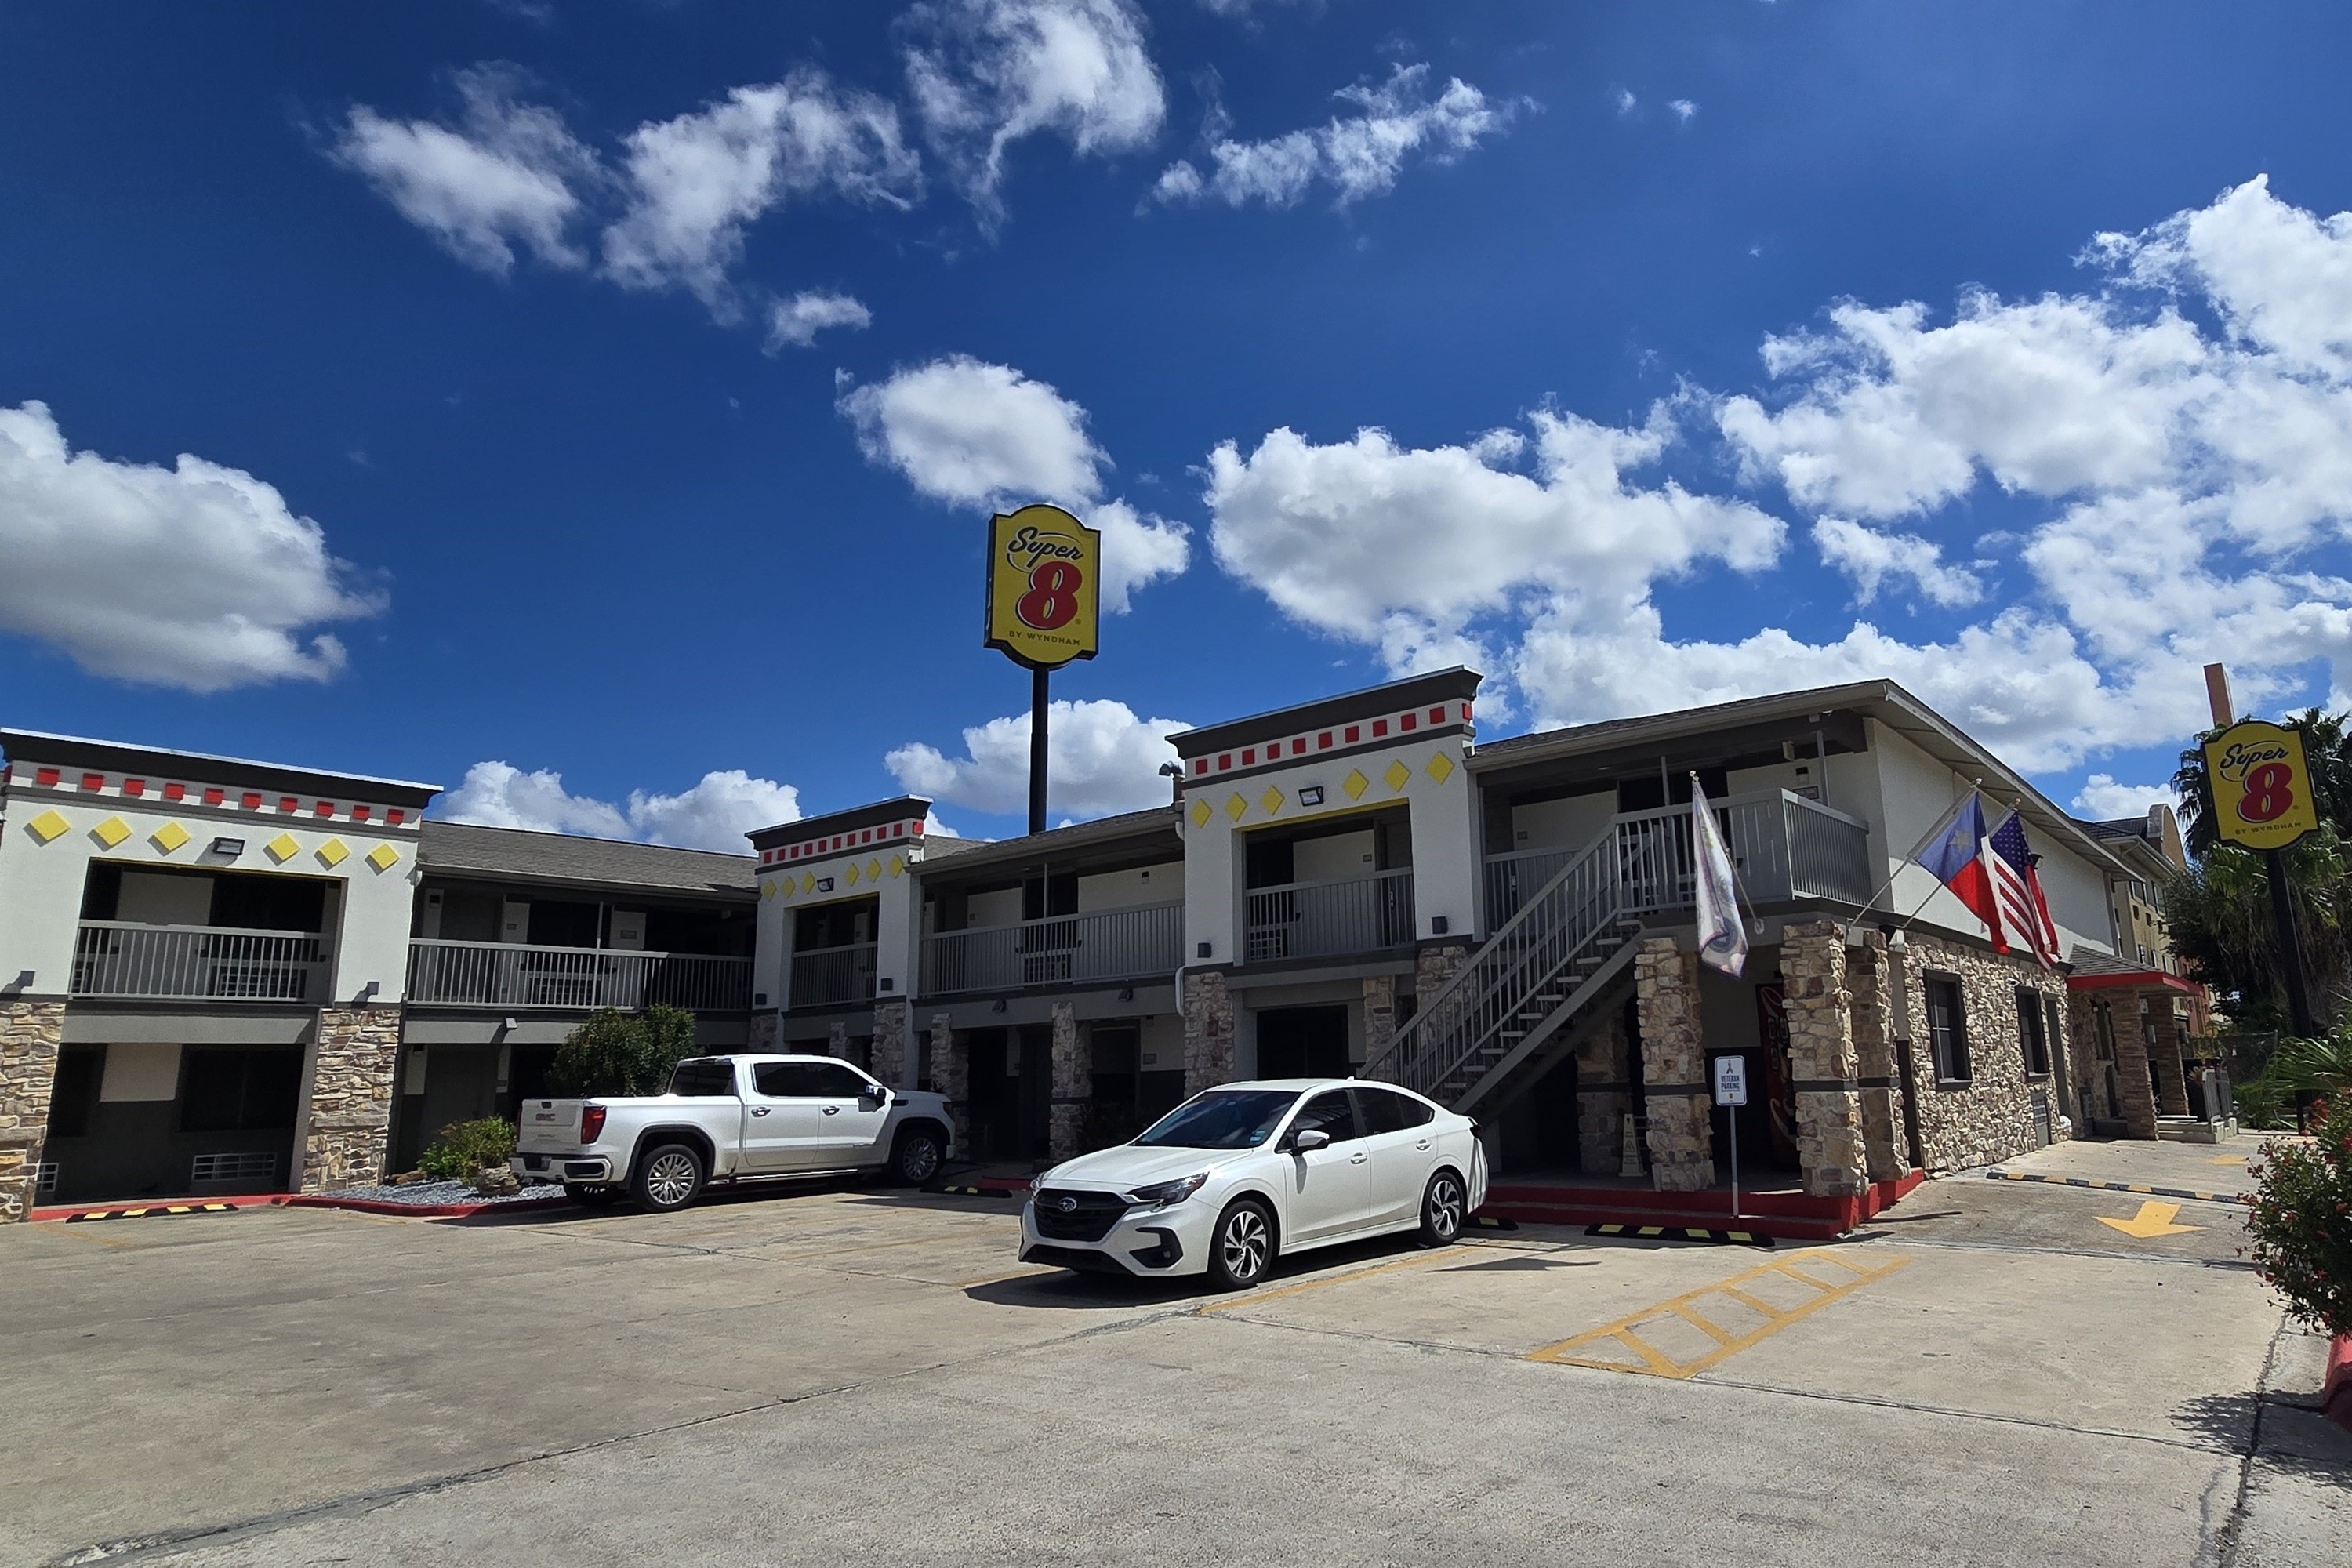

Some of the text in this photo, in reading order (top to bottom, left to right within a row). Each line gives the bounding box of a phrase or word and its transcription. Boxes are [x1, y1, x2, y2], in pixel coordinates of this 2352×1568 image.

[1007, 526, 1084, 569] Super
[1015, 560, 1083, 630] 8
[1026, 632, 1081, 646] WYNDHAM
[2220, 742, 2290, 777] Super
[2237, 762, 2294, 824] 8
[2250, 822, 2302, 833] WYNDHAM
